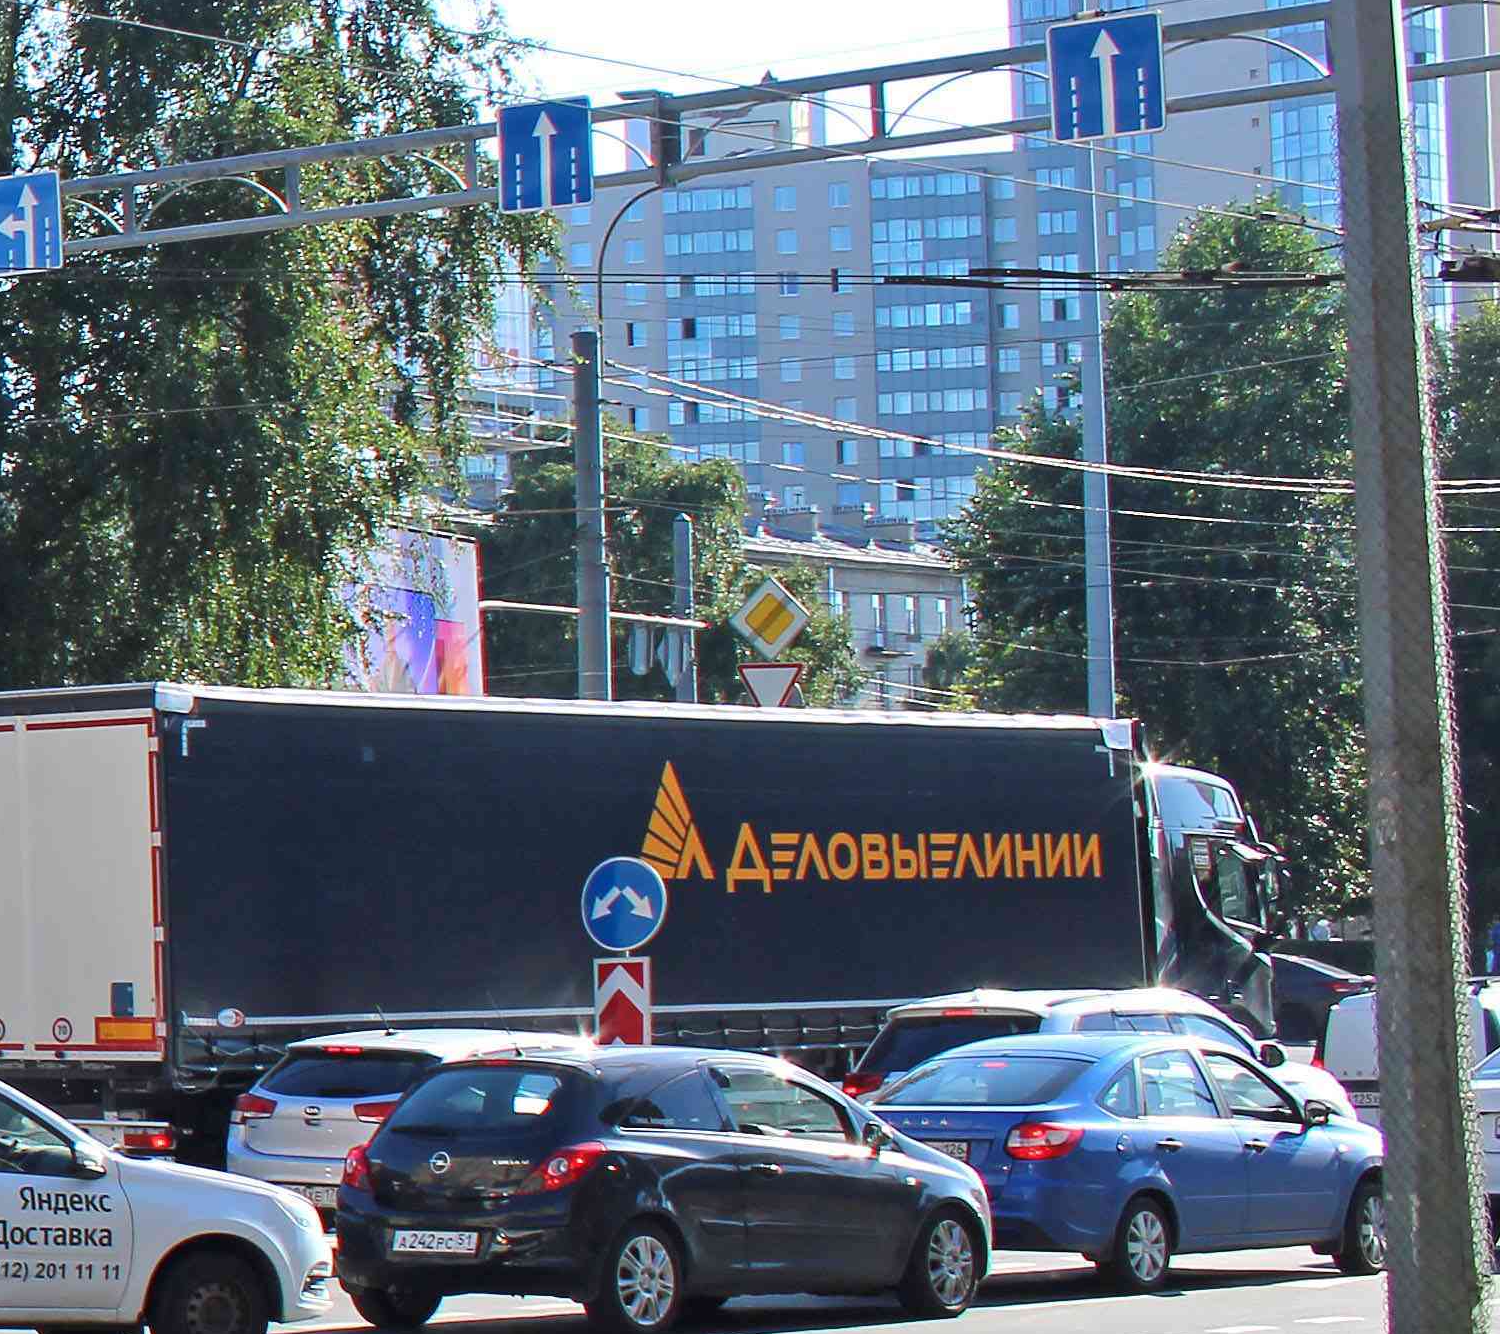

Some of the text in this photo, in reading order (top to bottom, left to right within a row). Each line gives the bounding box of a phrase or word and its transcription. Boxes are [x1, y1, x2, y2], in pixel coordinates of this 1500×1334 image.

[19, 1186, 112, 1214] Яндекс
[35, 1262, 66, 1279] 201
[75, 1263, 93, 1280] 11
[102, 1264, 120, 1281] 11
